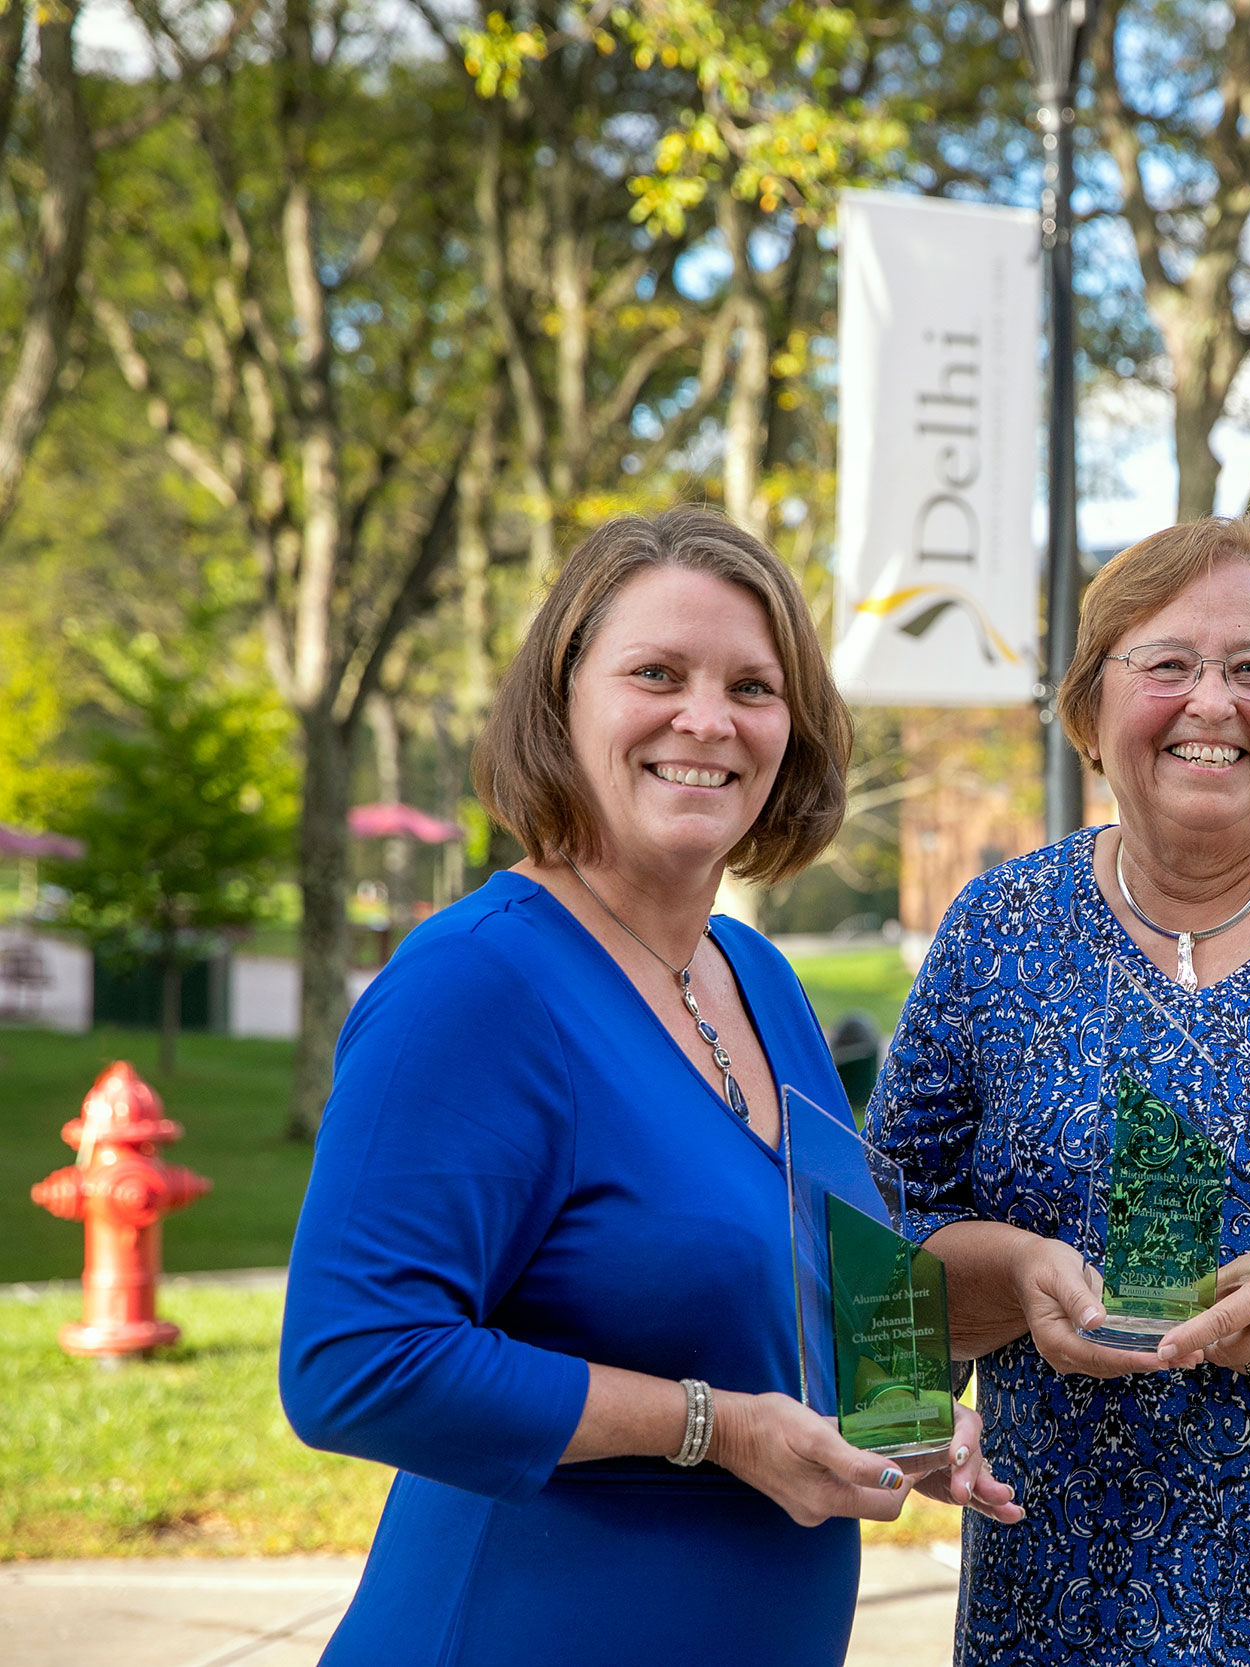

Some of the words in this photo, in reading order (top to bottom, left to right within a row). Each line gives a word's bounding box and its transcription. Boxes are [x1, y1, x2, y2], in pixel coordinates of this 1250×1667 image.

[912, 331, 980, 567] Delhi
[1119, 1168, 1180, 1183] Distinguished
[1153, 1195, 1181, 1208] Linda
[1131, 1207, 1167, 1221] Darling
[1170, 1210, 1200, 1222] Powell
[1120, 1272, 1162, 1287] SUNY
[852, 1294, 890, 1305] Alumna
[892, 1290, 902, 1301] of
[904, 1288, 930, 1300] Merit
[872, 1316, 914, 1330] Johanna
[852, 1331, 890, 1344] Church
[892, 1327, 935, 1340] DeSanto
